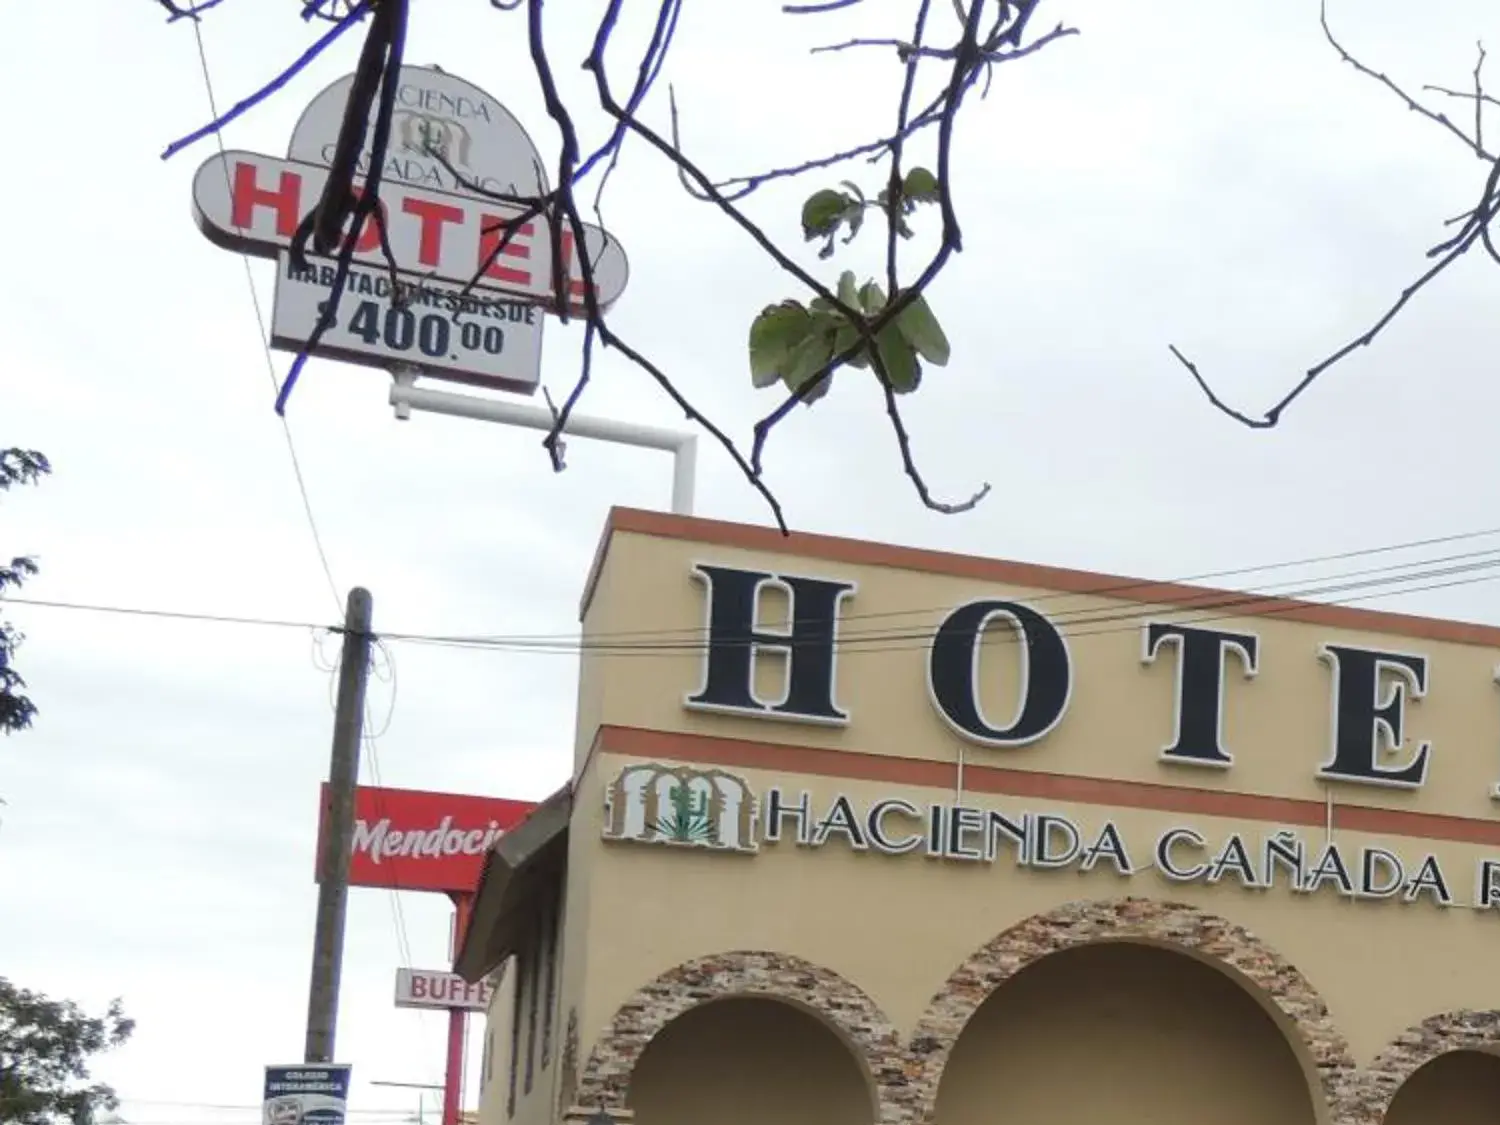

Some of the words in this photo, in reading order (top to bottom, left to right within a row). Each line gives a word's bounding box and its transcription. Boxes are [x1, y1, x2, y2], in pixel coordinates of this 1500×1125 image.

[394, 83, 491, 124] CIENDA
[321, 143, 443, 187] CADA
[287, 260, 460, 313] HABTACONES
[764, 787, 1134, 876] HACIENDA
[1155, 826, 1452, 906] CAÑADA
